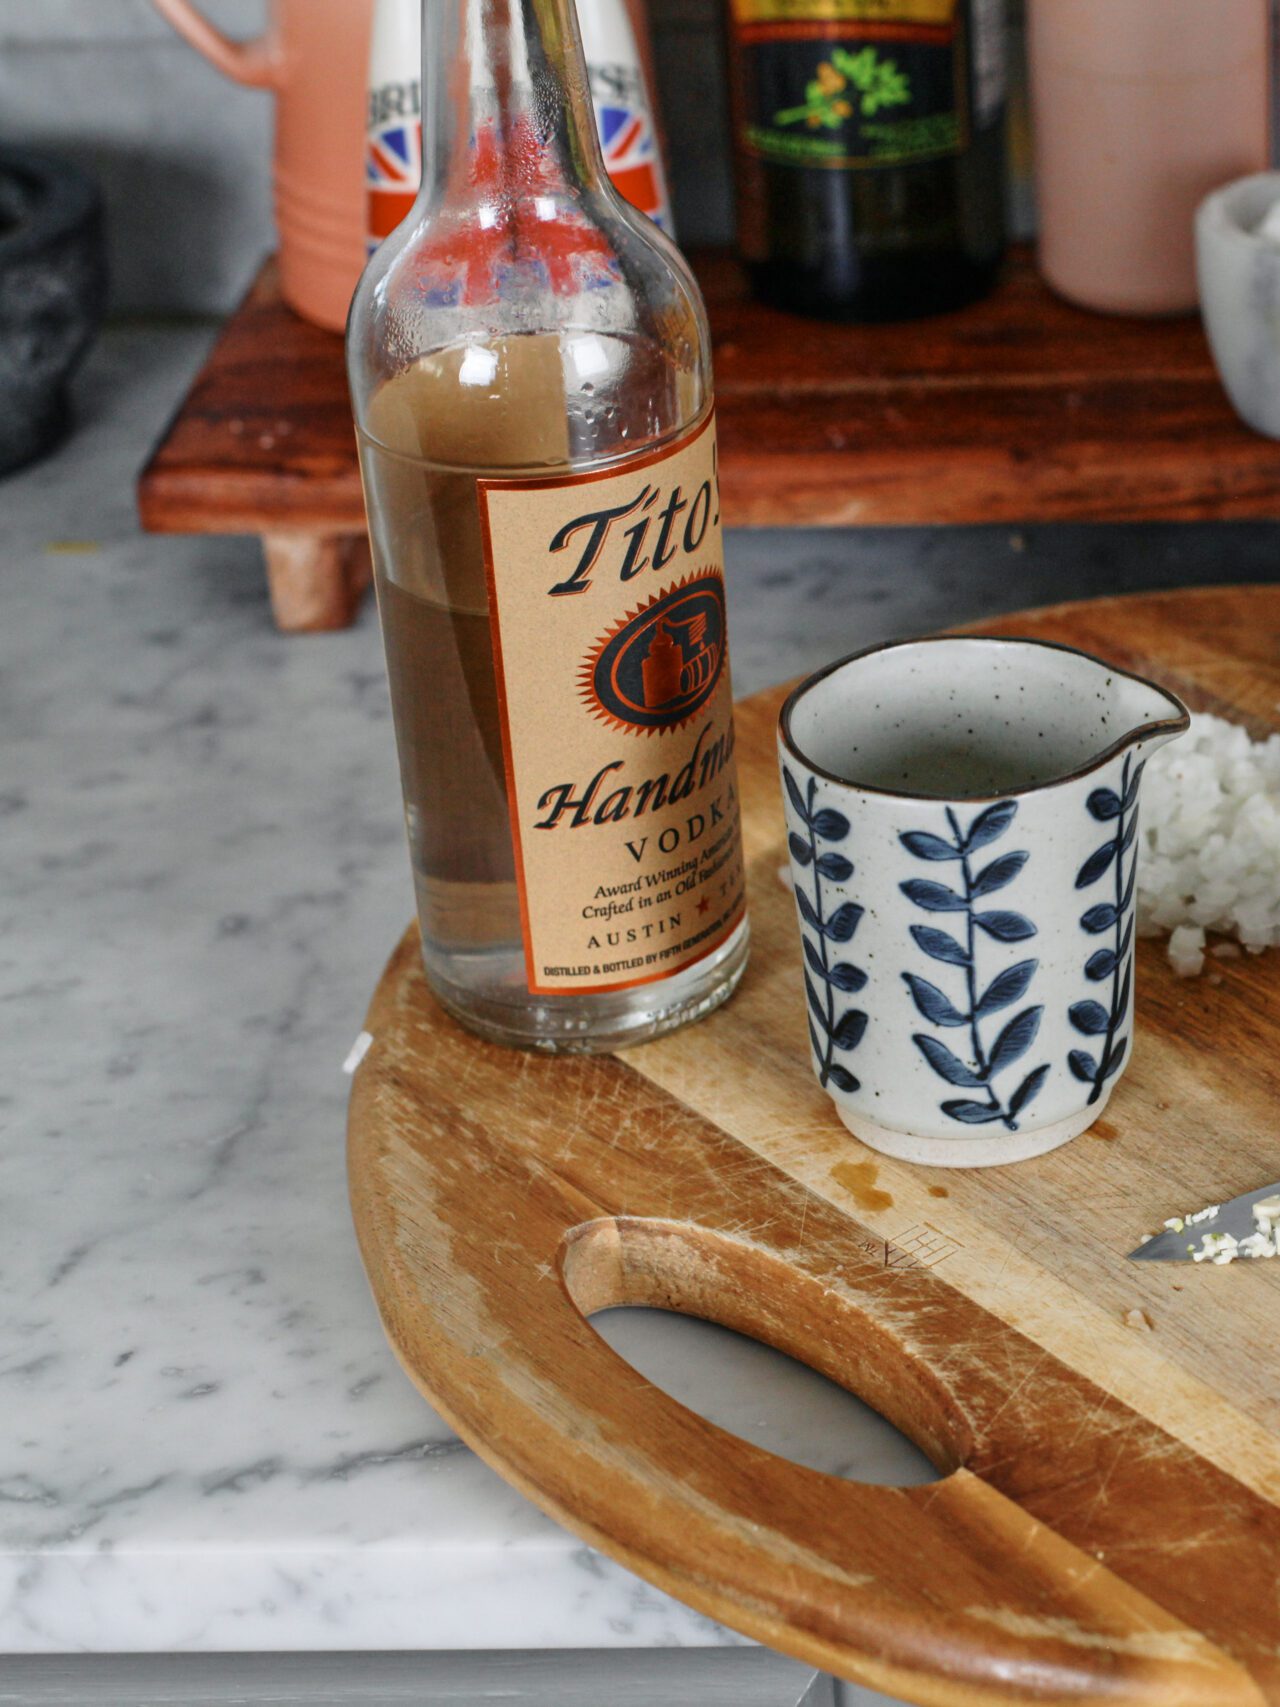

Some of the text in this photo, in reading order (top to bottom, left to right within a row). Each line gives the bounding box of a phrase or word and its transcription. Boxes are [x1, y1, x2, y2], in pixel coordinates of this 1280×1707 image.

[582, 896, 634, 922] Crafted
[638, 895, 653, 910] in
[656, 889, 673, 904] an
[675, 870, 697, 896] Old
[593, 875, 643, 899] Award
[644, 857, 699, 888] Winning
[587, 912, 682, 949] AUSTIN
[543, 964, 592, 977] DISTILLED
[593, 965, 601, 975] &
[602, 956, 644, 974] BOTTLED
[645, 952, 658, 965] BY
